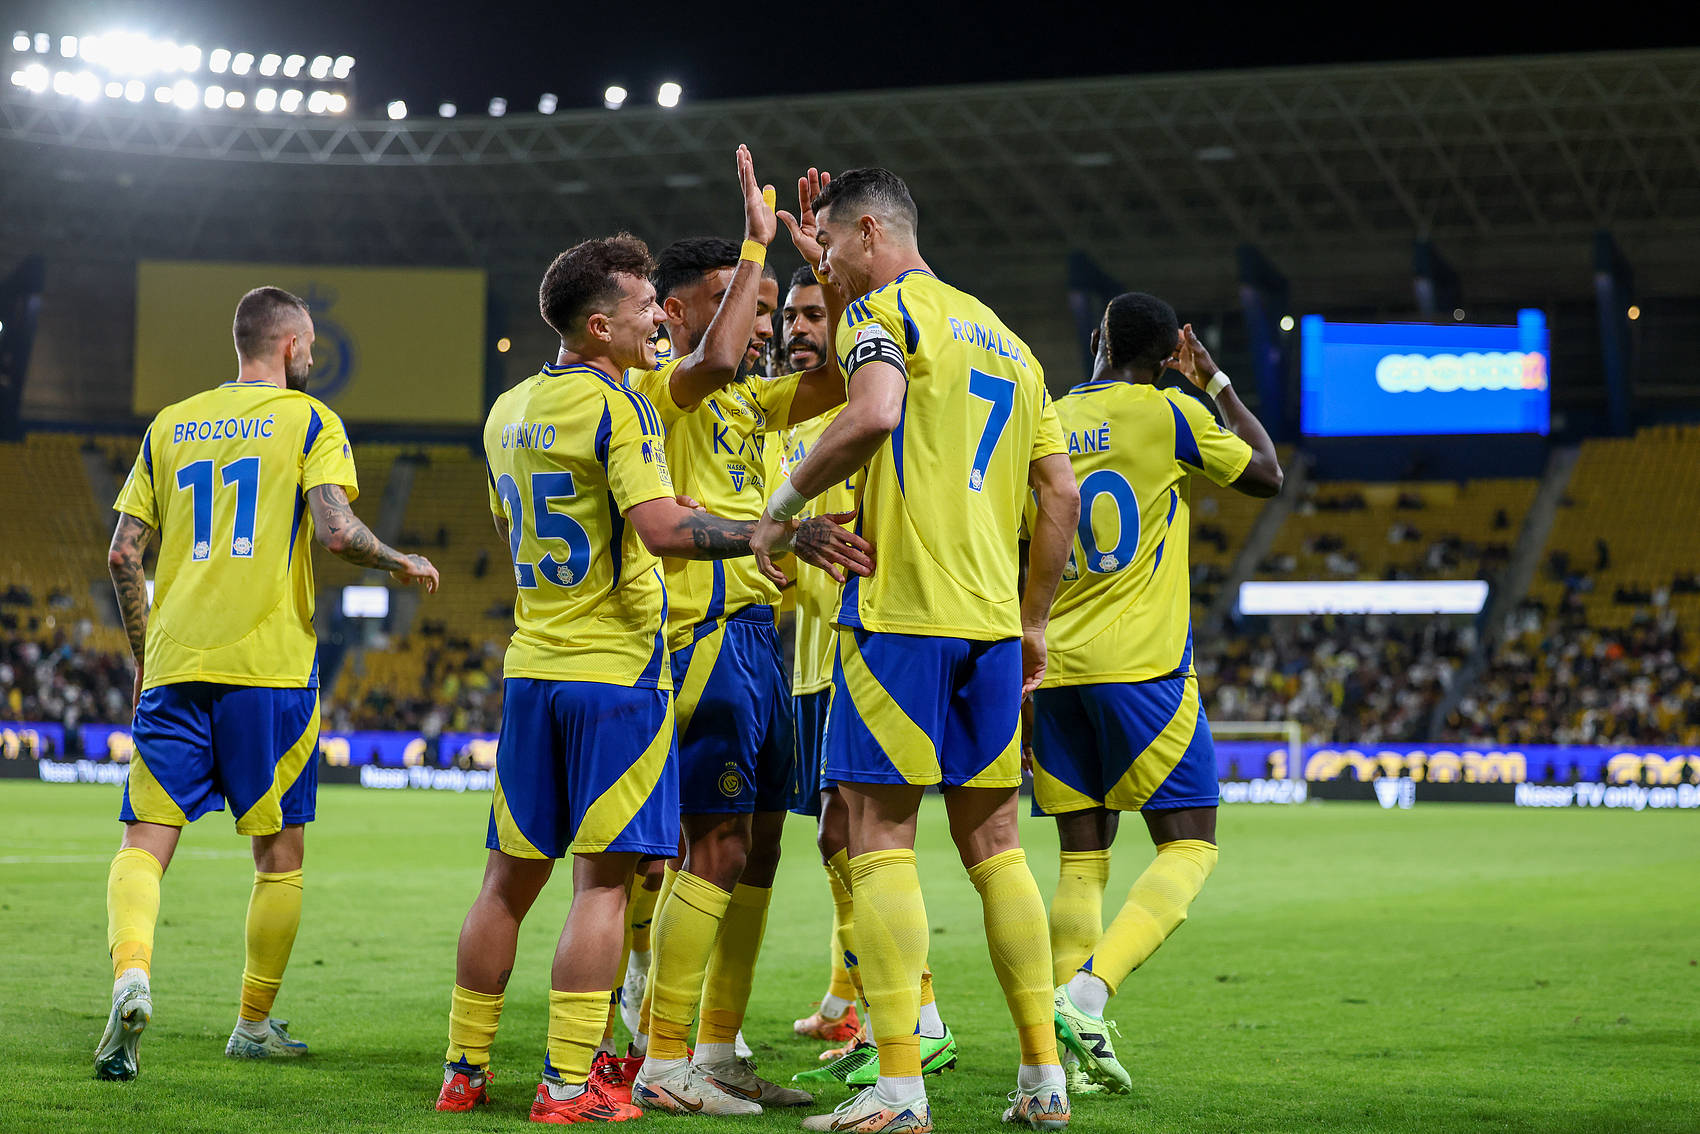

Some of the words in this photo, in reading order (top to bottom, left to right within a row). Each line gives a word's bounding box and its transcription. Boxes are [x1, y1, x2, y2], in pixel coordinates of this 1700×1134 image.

[948, 316, 1027, 368] RONALDO
[173, 414, 274, 444] BROZOVIĆ
[727, 463, 746, 471] NASSR
[968, 366, 1018, 493] 7
[1064, 422, 1111, 455] ANÉ
[176, 456, 261, 562] 11
[496, 472, 592, 589] 25
[1062, 468, 1141, 582] 0
